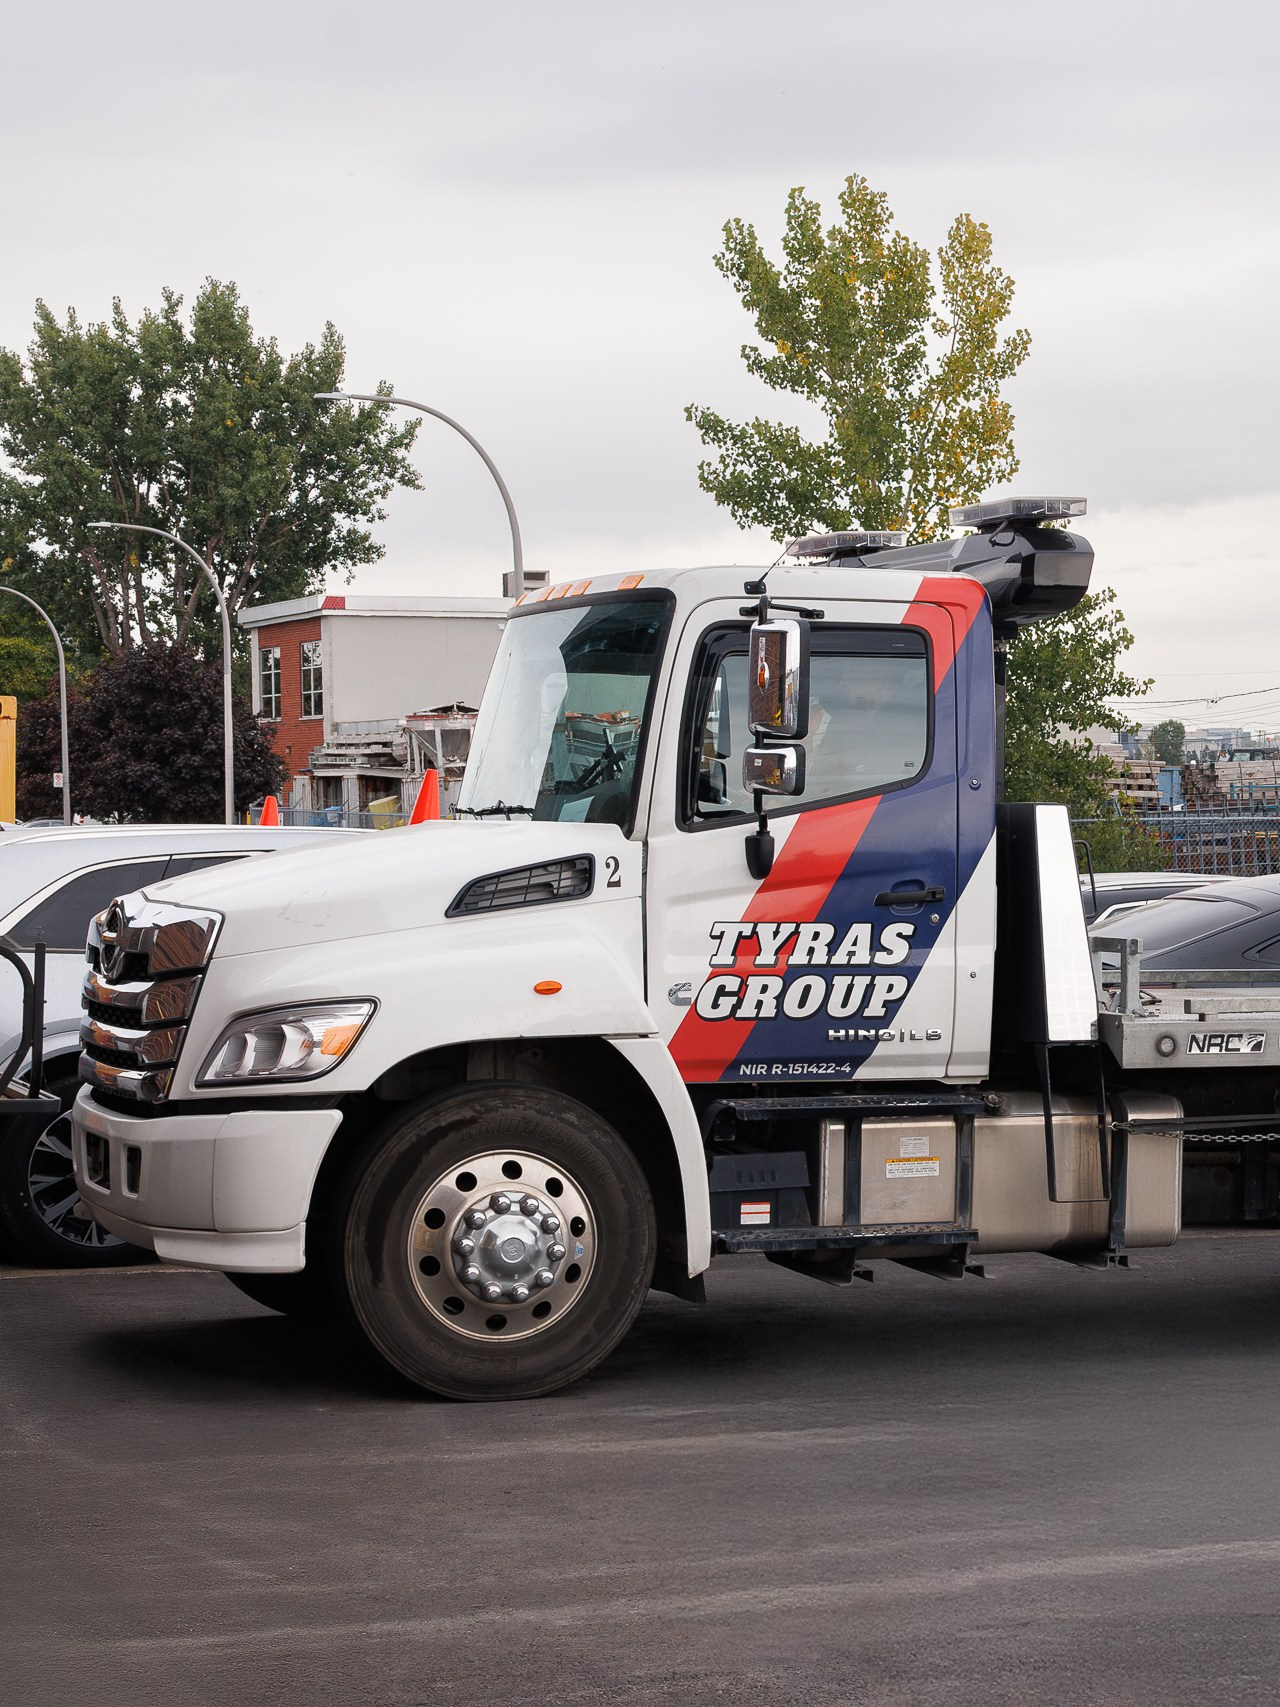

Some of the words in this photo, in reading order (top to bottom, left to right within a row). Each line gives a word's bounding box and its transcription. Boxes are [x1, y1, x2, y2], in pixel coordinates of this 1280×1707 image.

[605, 856, 621, 887] 2
[709, 922, 916, 967] TYRAS
[695, 975, 909, 1019] GROUP
[1188, 1033, 1243, 1052] NRC
[740, 1064, 767, 1075] NIR
[772, 1063, 851, 1075] R-151422-4
